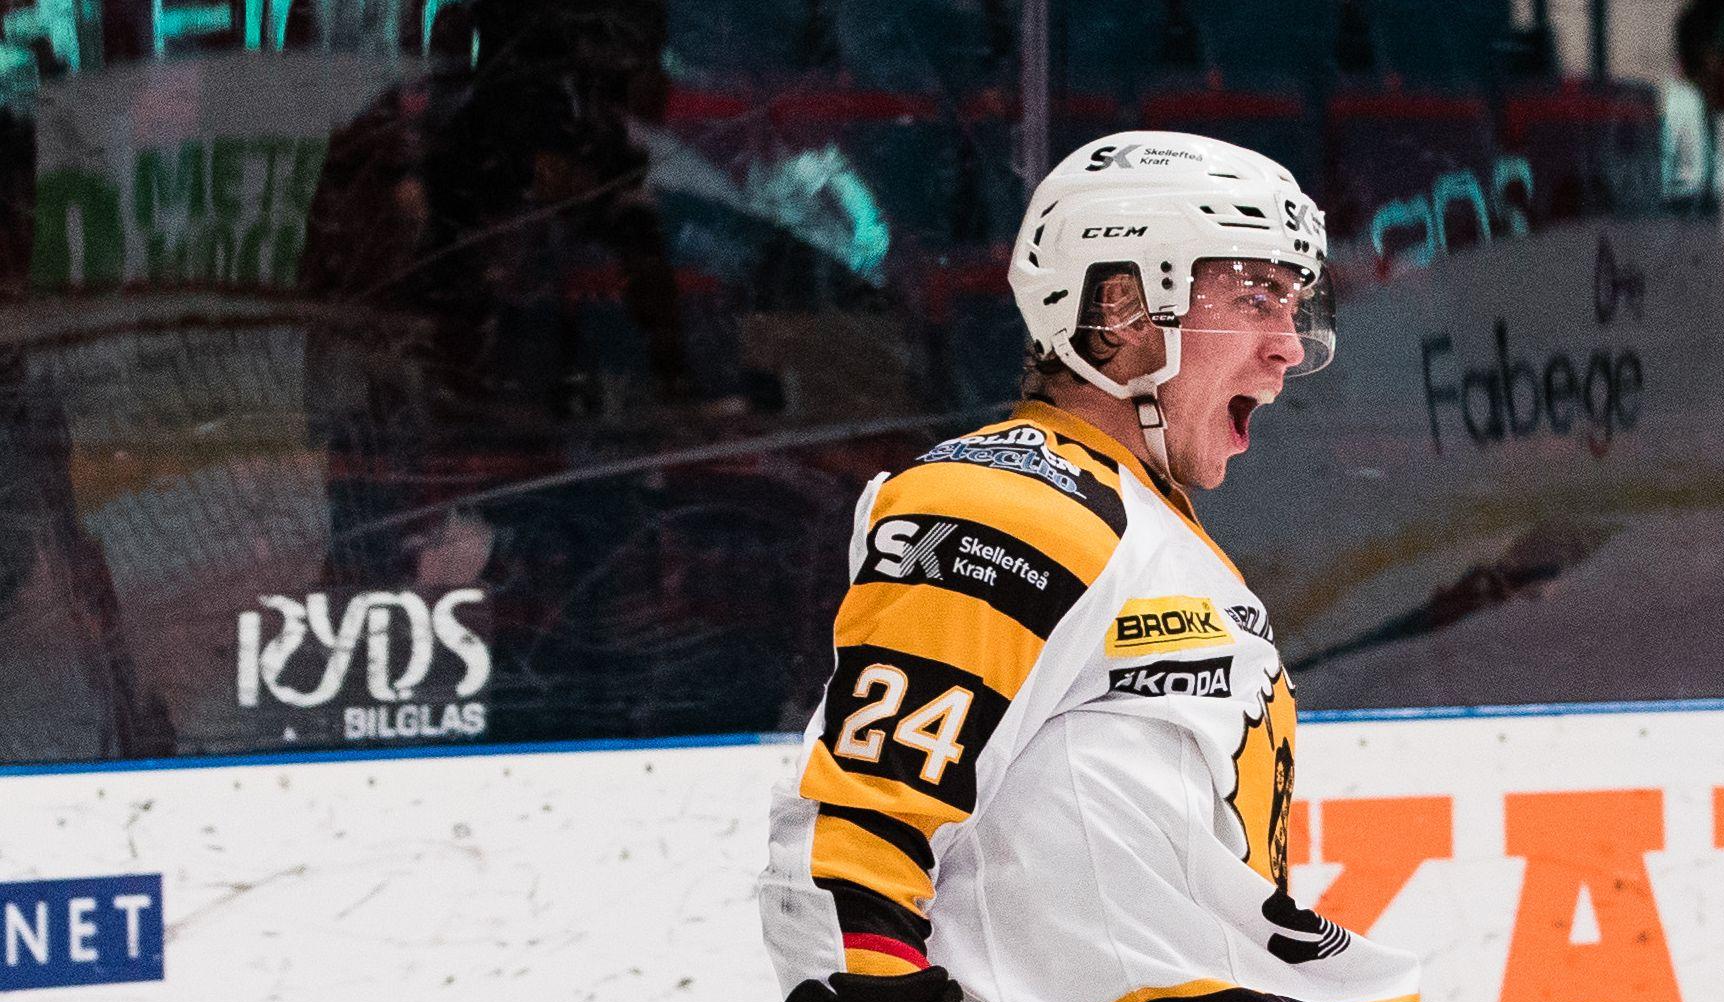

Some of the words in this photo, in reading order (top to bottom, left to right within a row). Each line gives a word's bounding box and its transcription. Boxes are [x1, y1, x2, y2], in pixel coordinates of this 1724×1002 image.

[1140, 157, 1170, 166] Kraft
[1082, 226, 1148, 239] CCM
[1421, 316, 1644, 460] Fabege
[952, 556, 998, 587] Kraft
[958, 535, 1050, 591] Skellefteå
[237, 588, 491, 708] RYDS
[1115, 609, 1223, 641] BROKK
[344, 702, 487, 740] BILGLAS
[834, 663, 975, 786] 24
[5, 895, 152, 967] NET
